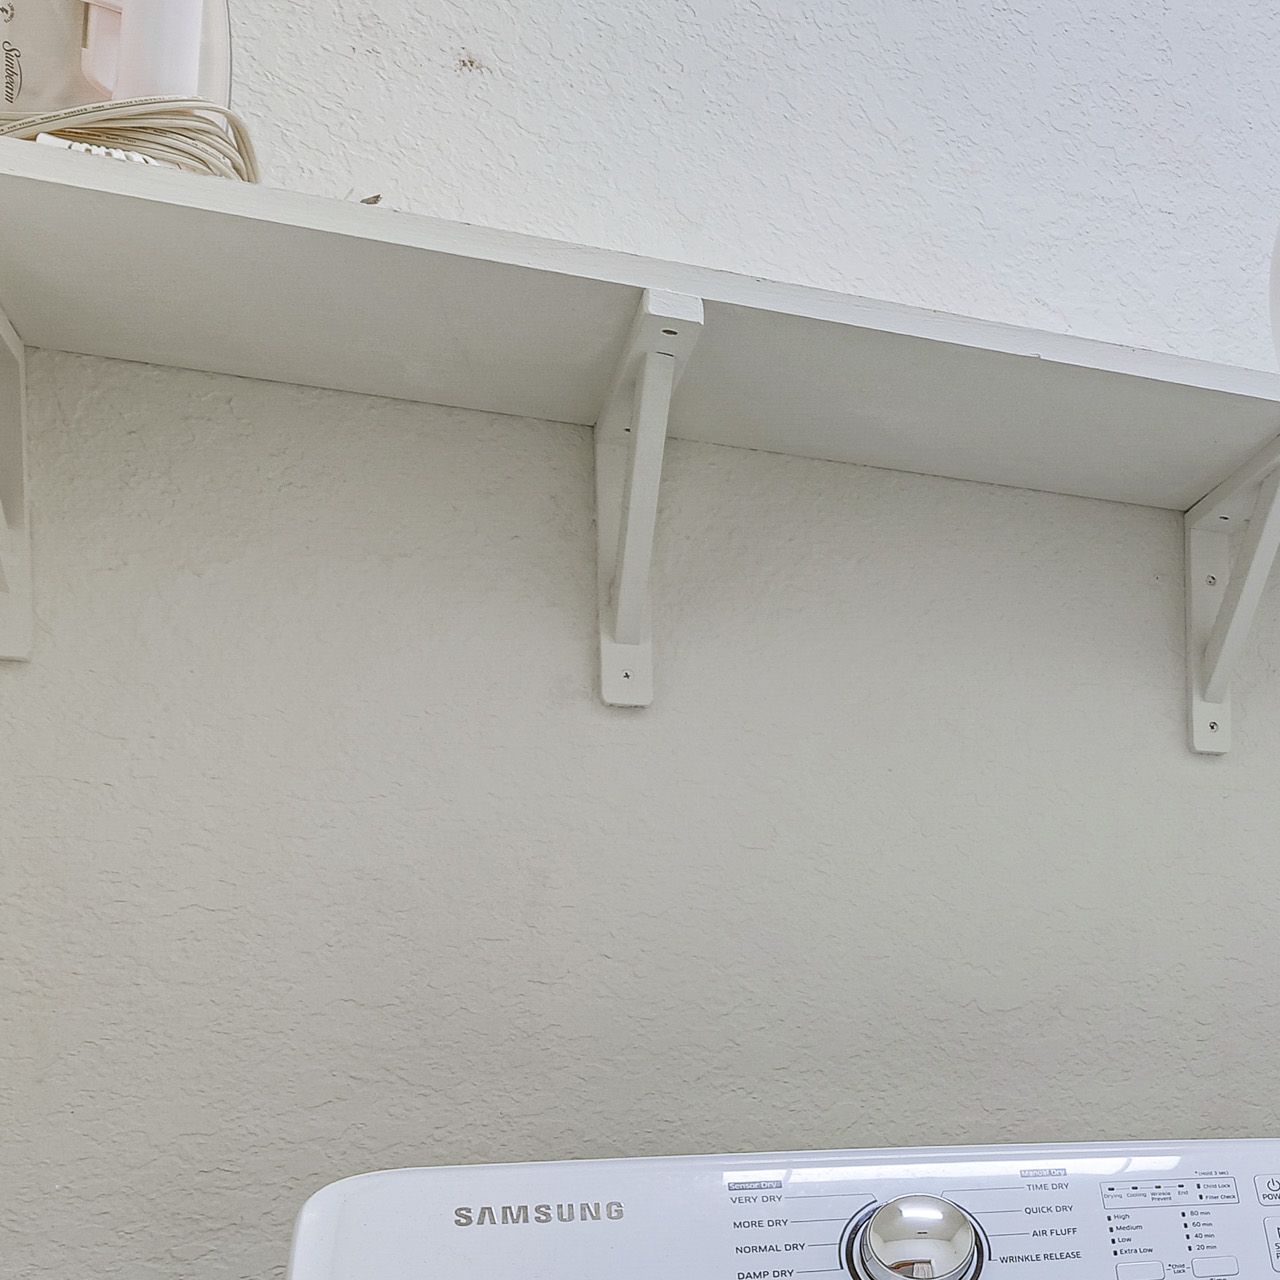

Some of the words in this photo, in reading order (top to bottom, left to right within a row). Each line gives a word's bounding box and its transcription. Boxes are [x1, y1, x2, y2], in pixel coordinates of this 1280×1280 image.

[2, 40, 21, 104] Sunbeam
[761, 1181, 778, 1190] Dry
[1026, 1183, 1050, 1191] TIME
[1051, 1182, 1070, 1190] DRY
[729, 1195, 758, 1204] VERY
[761, 1195, 783, 1203] DRY
[454, 1201, 624, 1227] SAMSUNG
[1024, 1206, 1053, 1215] QUICK
[1055, 1204, 1074, 1213] DRY
[1113, 1213, 1130, 1221] High
[733, 1220, 765, 1229] MORE
[767, 1219, 788, 1227] DRY
[1115, 1224, 1143, 1232] Medium
[1031, 1229, 1048, 1238] AIR
[1049, 1227, 1077, 1236] FLUFF
[735, 1244, 782, 1254] NORMAL
[784, 1242, 806, 1252] DRY
[999, 1253, 1041, 1264] WRINKLE
[1043, 1251, 1082, 1261] RELEASE
[737, 1270, 770, 1280] DAMP
[772, 1269, 794, 1278] DRY
